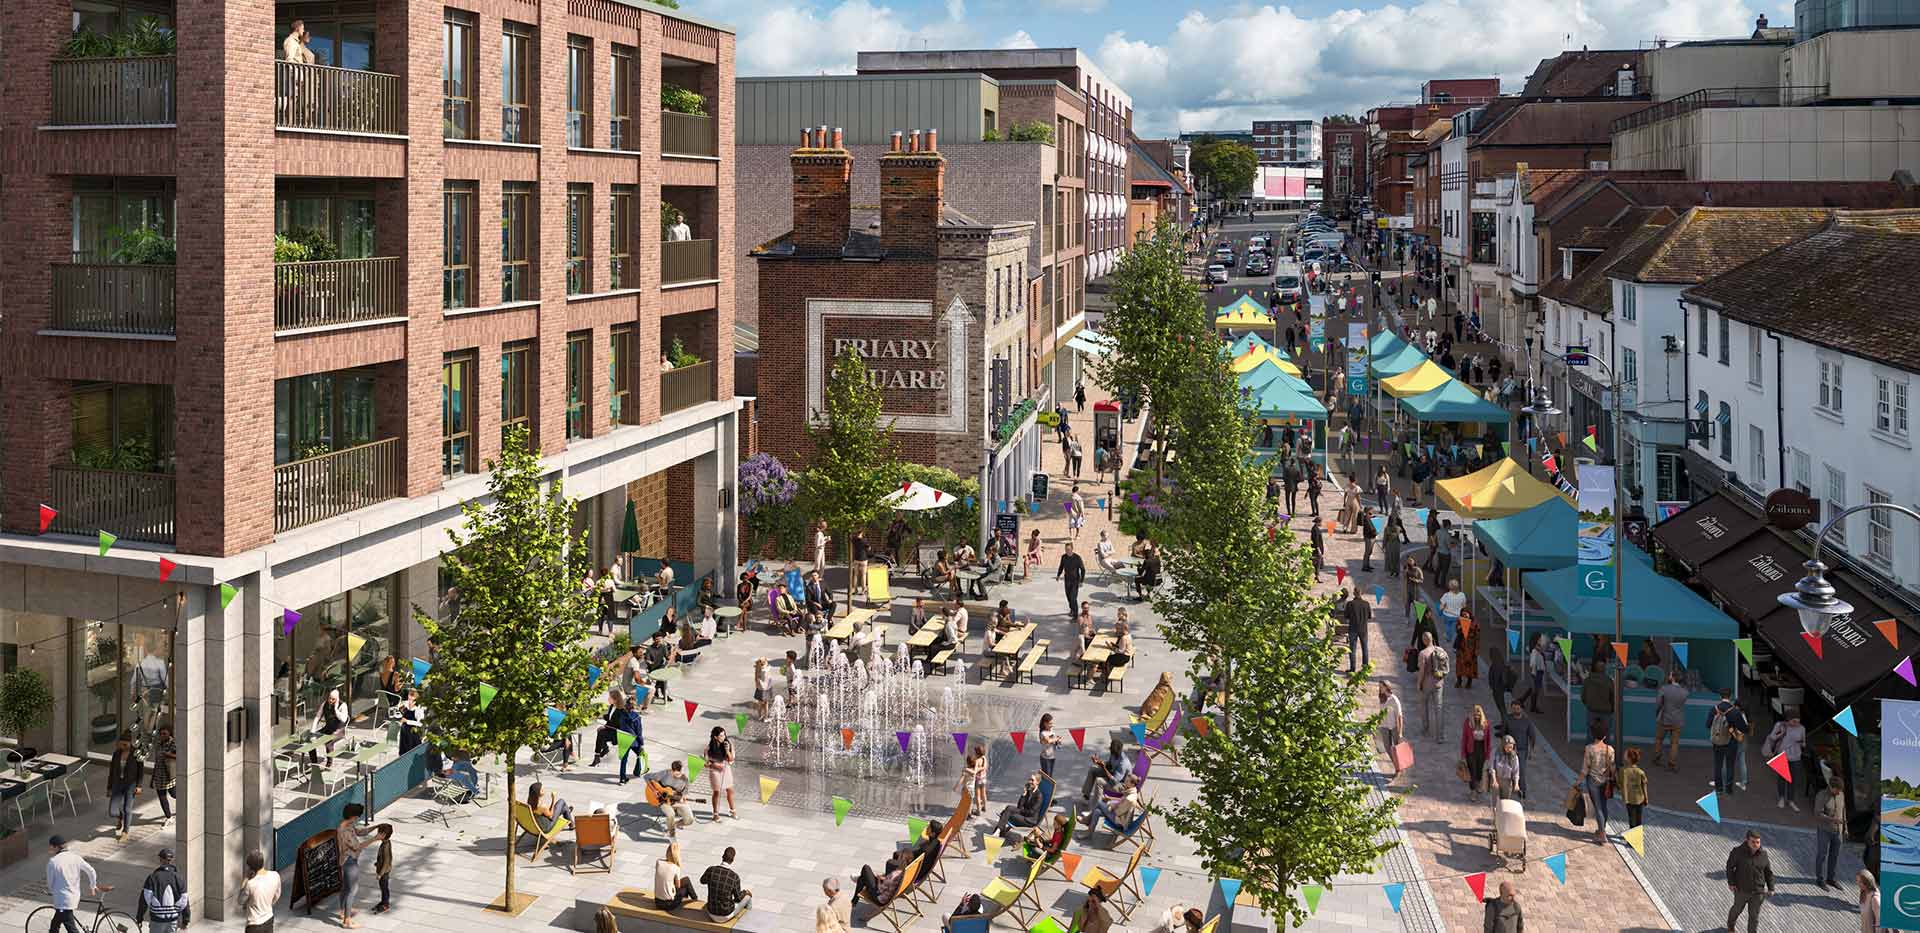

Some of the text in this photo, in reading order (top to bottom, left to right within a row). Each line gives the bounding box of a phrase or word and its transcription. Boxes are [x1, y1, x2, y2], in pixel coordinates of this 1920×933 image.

[833, 338, 938, 359] FRIARY
[831, 368, 945, 389] SUARE
[1585, 570, 1609, 591] G
[1830, 613, 1867, 648] aitouna
